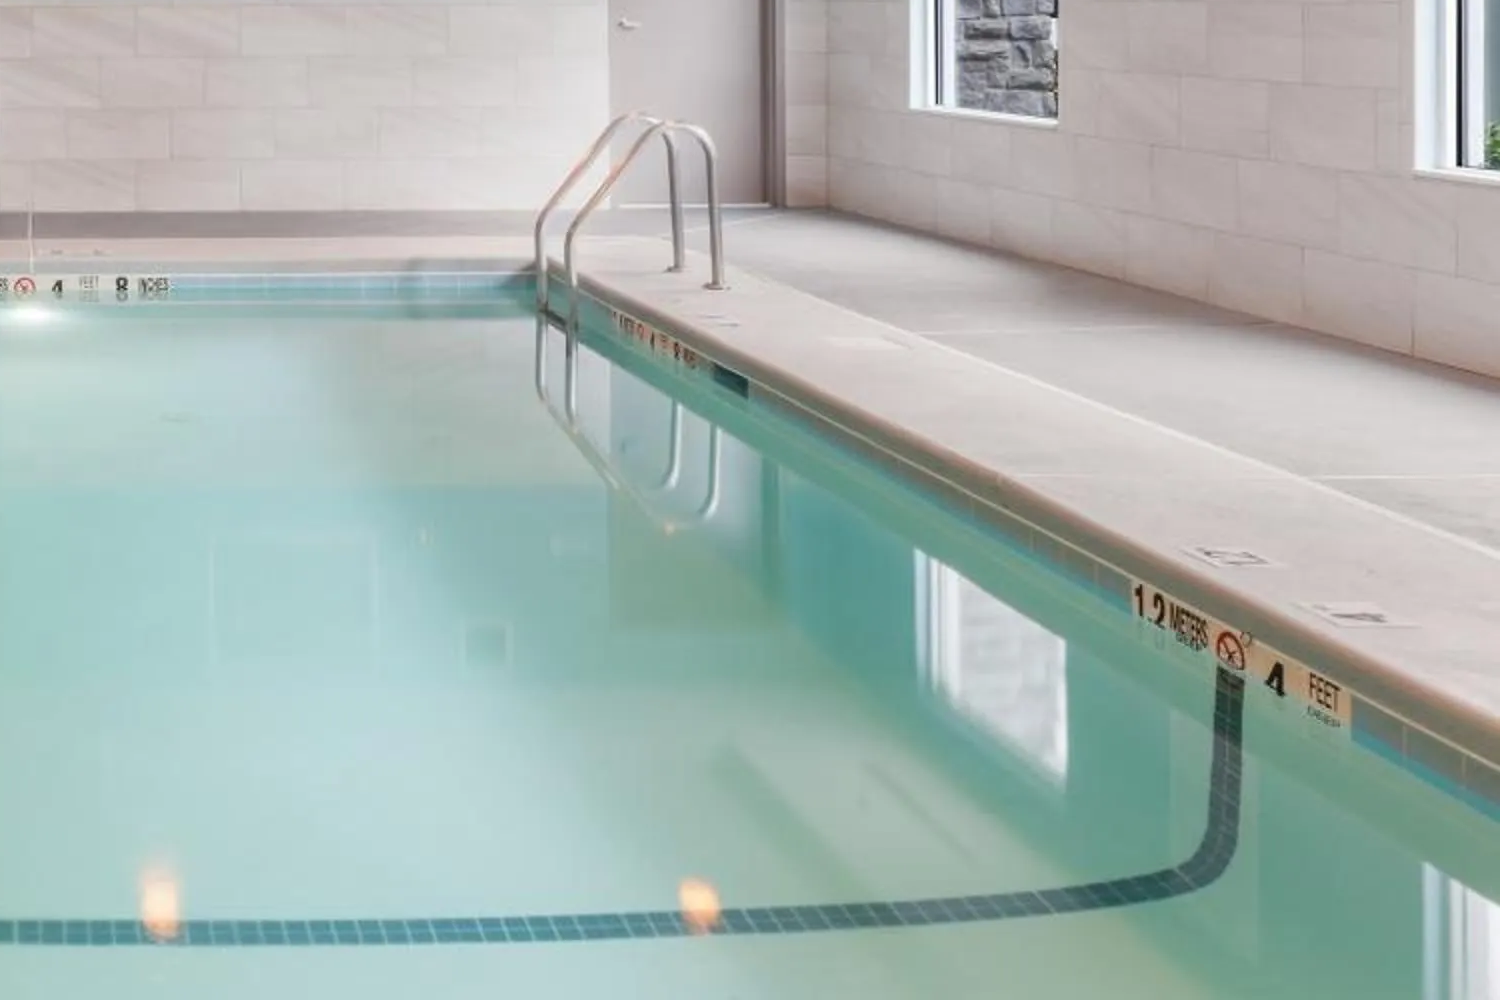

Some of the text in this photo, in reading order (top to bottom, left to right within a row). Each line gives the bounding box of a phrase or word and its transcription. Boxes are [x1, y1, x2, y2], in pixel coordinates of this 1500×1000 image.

[52, 279, 63, 292] 4
[116, 277, 128, 291] 8
[1169, 602, 1208, 650] METERS
[1265, 661, 1285, 697] 4
[1309, 672, 1341, 712] FEET
